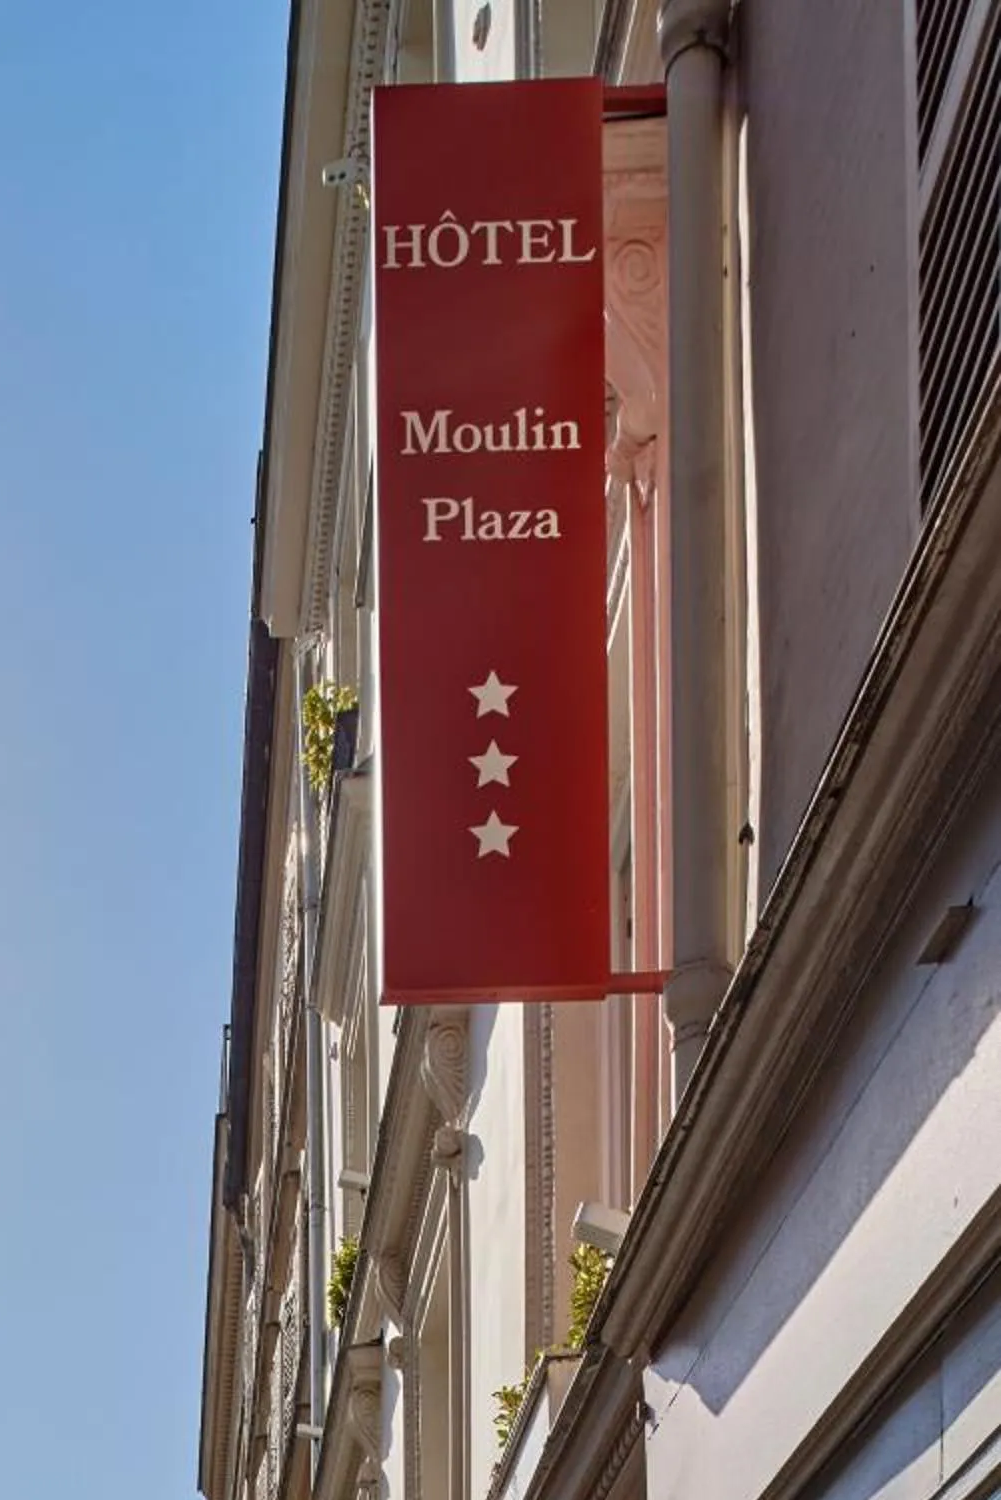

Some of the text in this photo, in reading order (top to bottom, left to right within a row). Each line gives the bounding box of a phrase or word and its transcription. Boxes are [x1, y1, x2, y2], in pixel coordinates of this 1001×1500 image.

[382, 209, 597, 270] HÔTEL
[400, 407, 582, 456] Moulin
[421, 497, 562, 542] Plaza
